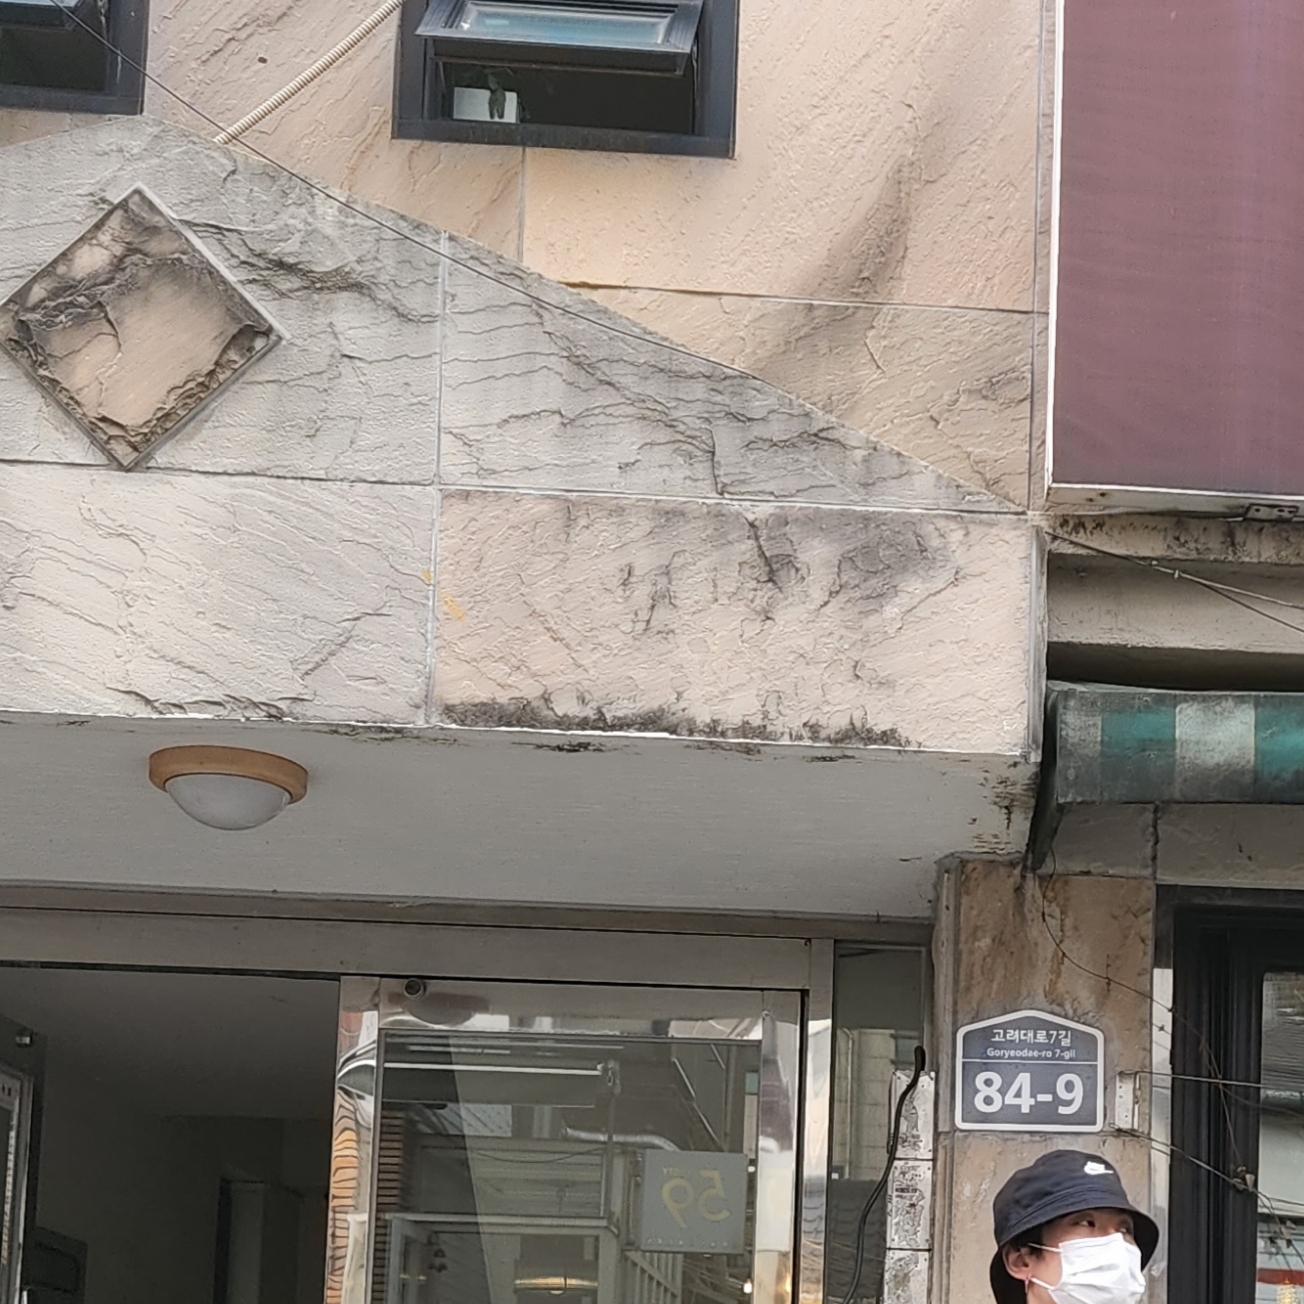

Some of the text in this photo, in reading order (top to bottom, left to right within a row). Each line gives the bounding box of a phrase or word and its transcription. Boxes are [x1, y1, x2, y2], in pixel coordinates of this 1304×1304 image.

[990, 1029, 1072, 1046] 고려대로7길
[986, 1047, 1076, 1059] Goryeodae-ro 7-gil
[974, 1071, 1084, 1114] 84-9
